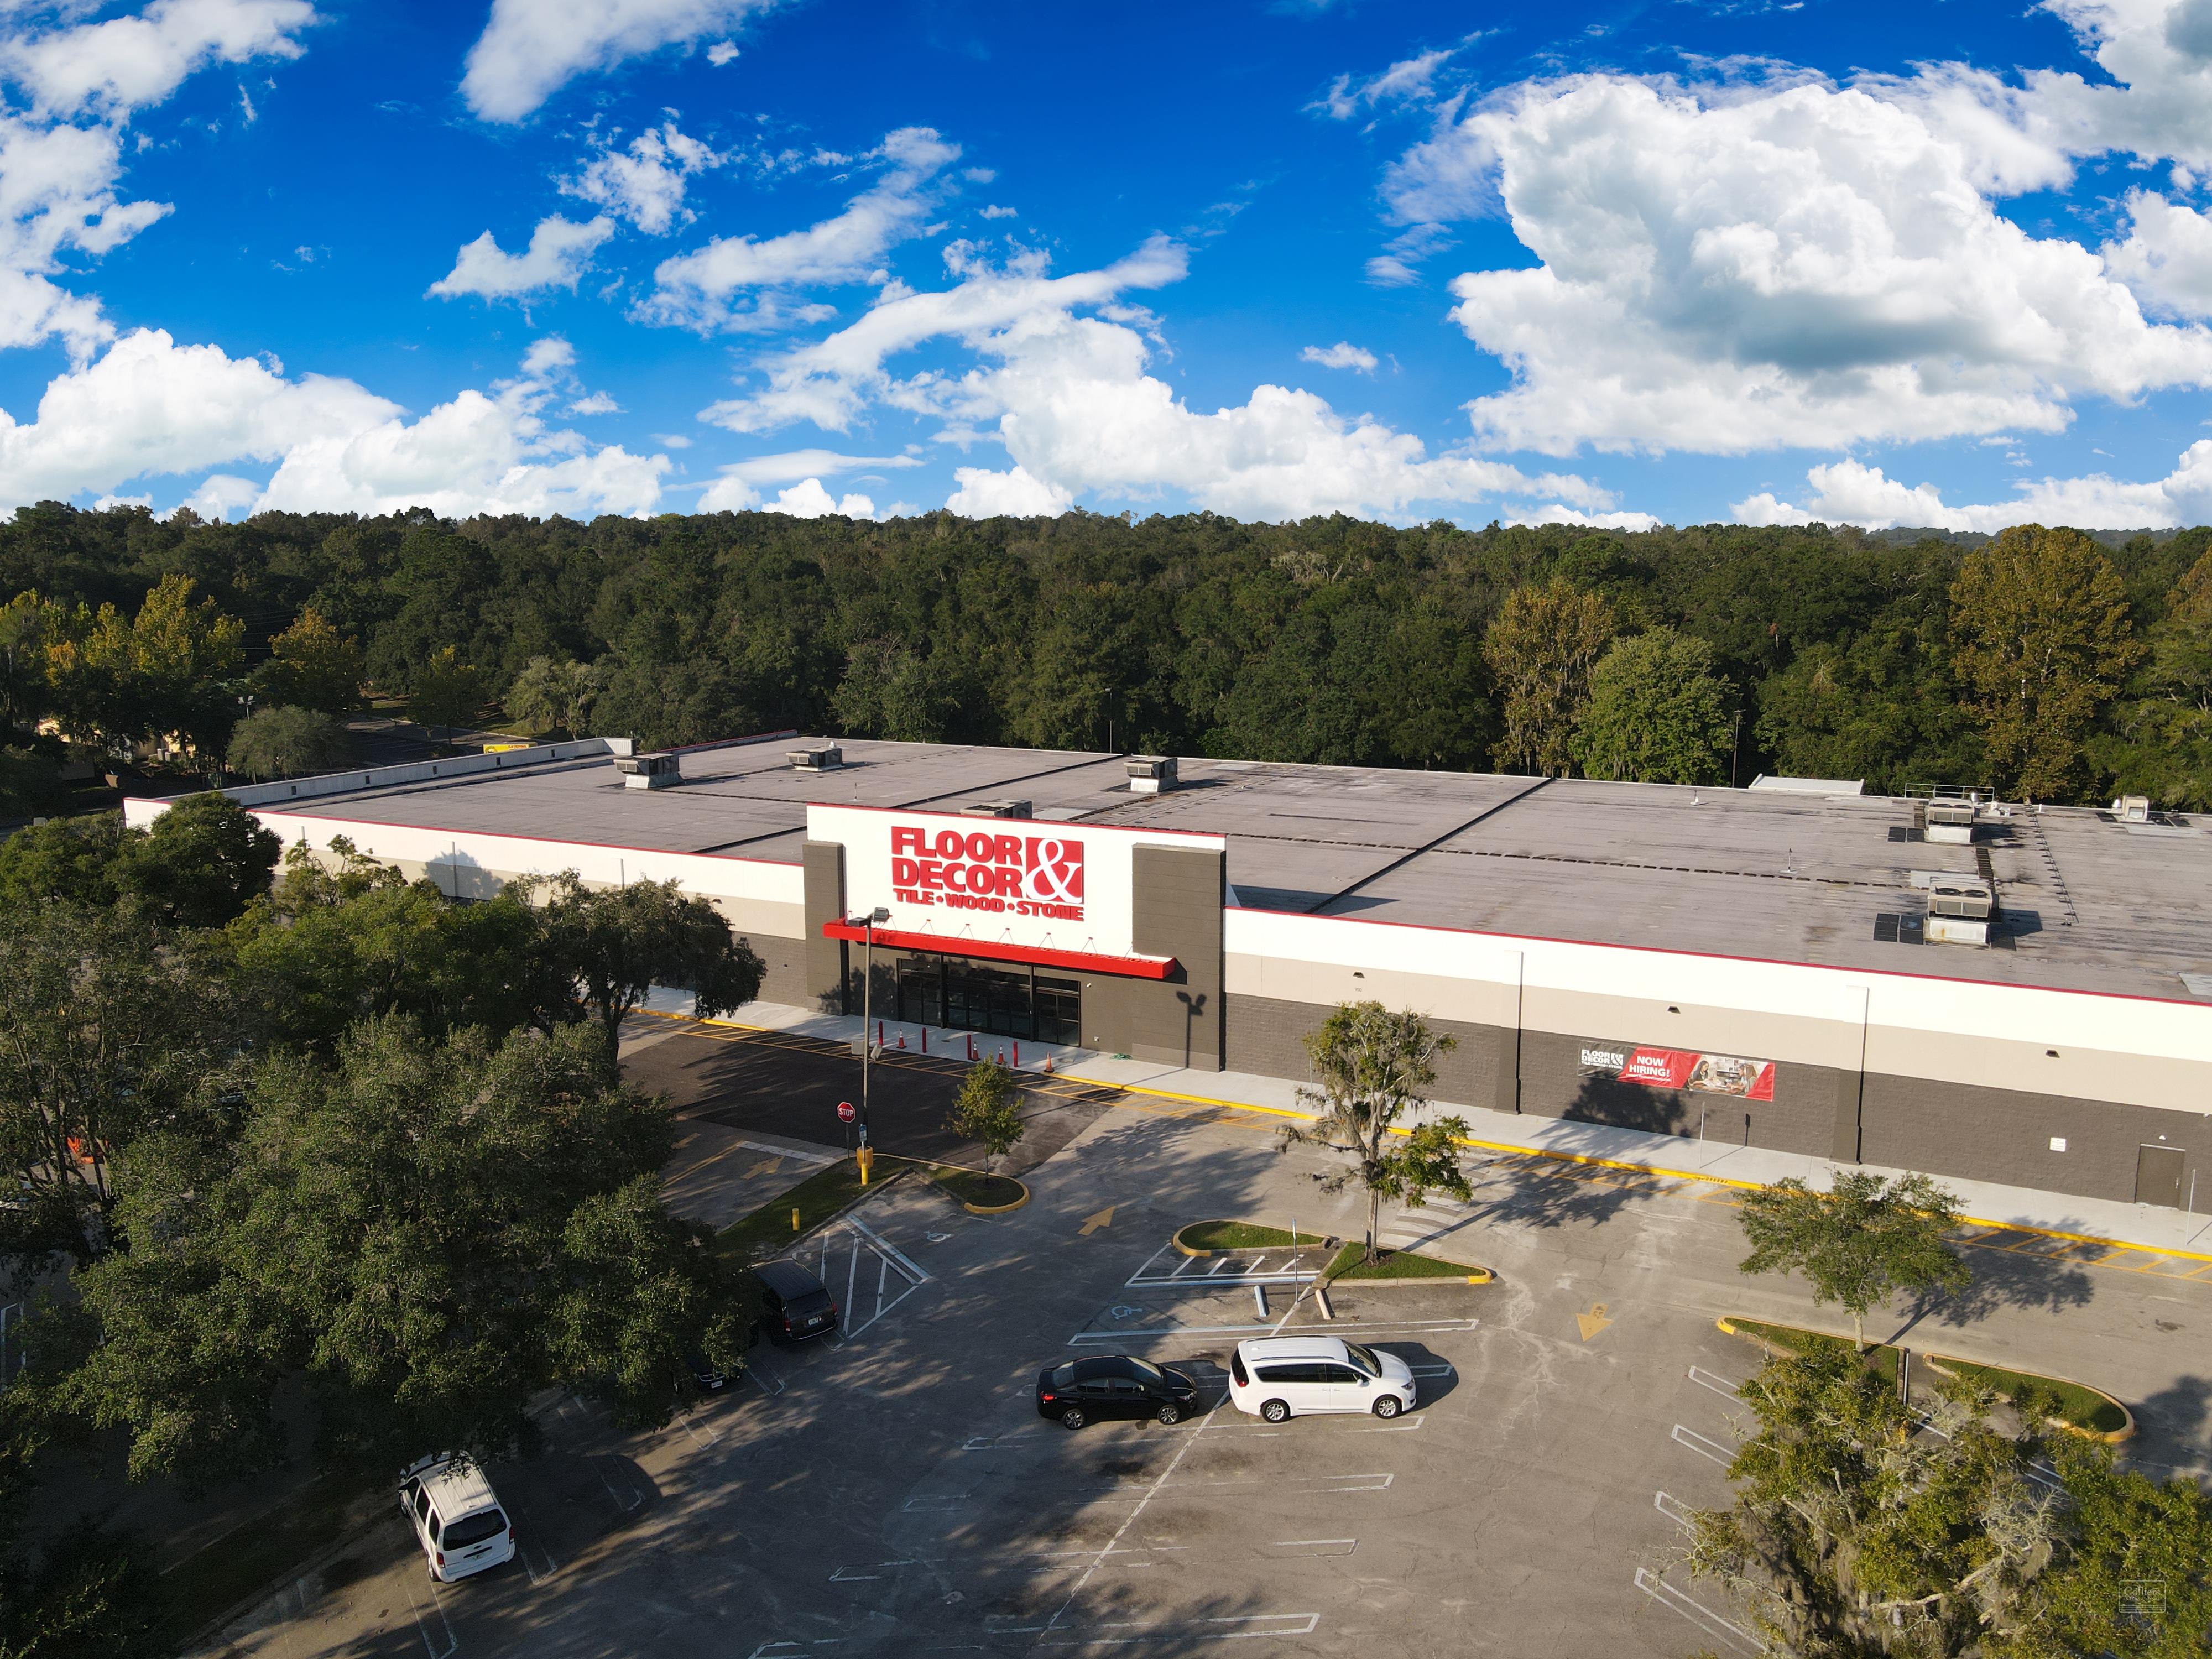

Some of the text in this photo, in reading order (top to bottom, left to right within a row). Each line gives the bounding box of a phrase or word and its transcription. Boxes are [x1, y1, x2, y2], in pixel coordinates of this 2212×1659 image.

[891, 826, 1084, 905] FLOOR &
[891, 857, 1023, 899] DECOR
[893, 888, 1085, 922] TILE WOOD STONE
[1581, 1055, 1610, 1065] DECOR
[1582, 1049, 1611, 1059] FLOOR
[1637, 1056, 1664, 1067] NOW
[1629, 1064, 1670, 1077] HIRING!
[839, 1108, 853, 1117] STOP
